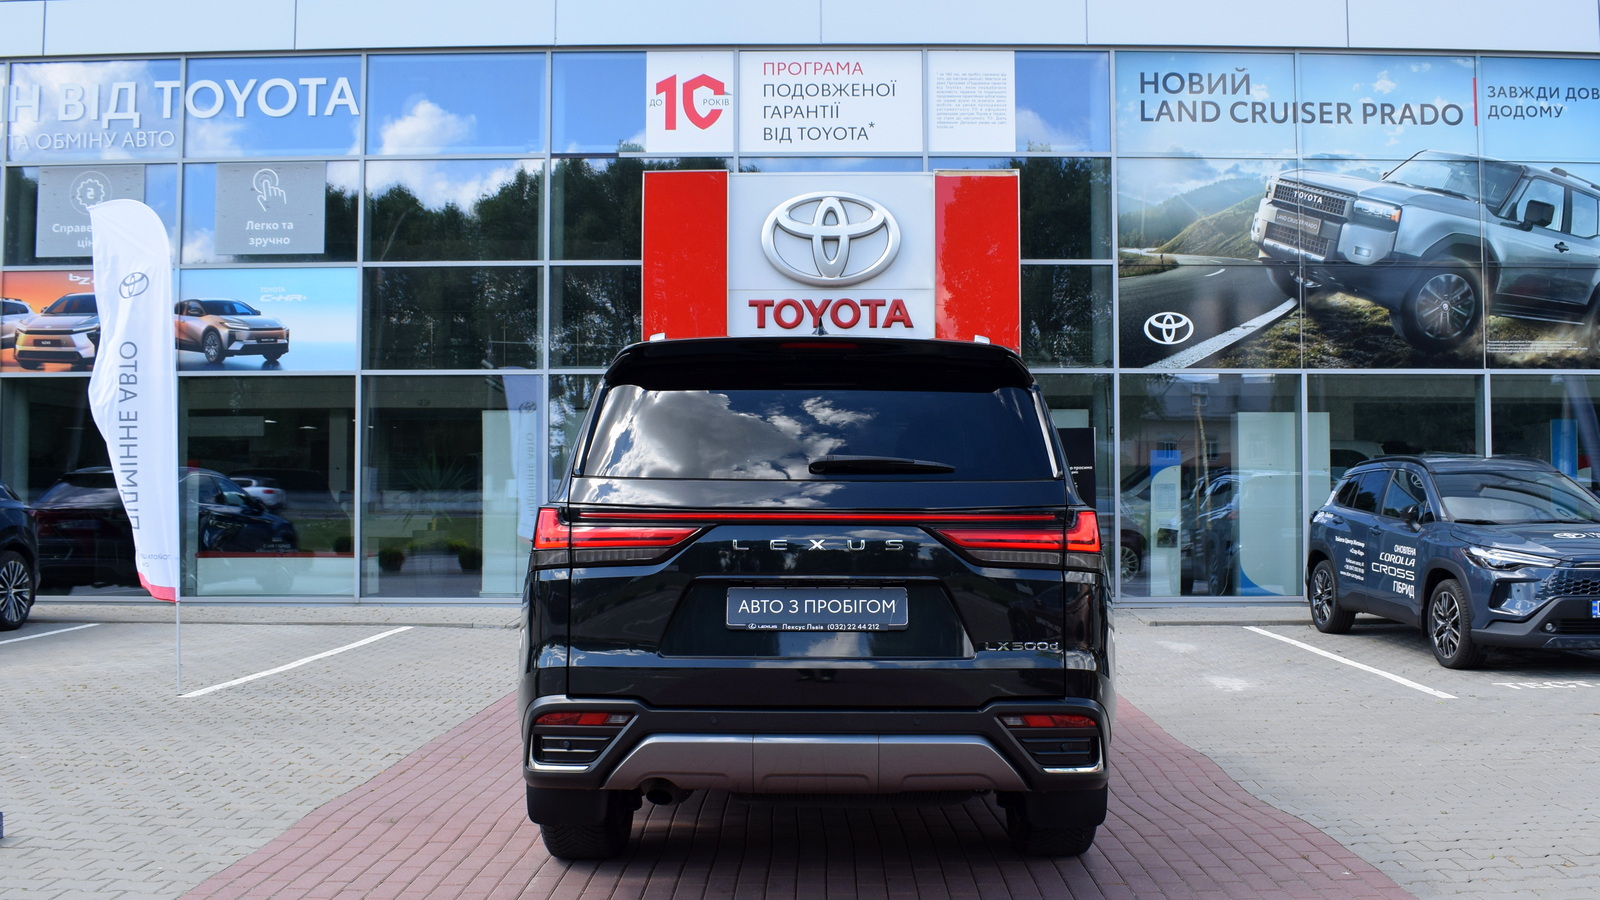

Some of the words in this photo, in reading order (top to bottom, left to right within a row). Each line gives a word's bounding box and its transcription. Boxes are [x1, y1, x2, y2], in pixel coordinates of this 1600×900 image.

[763, 62, 864, 76] ПРОГРАМА
[763, 79, 896, 99] ПОДОВЖЕНОЇ
[1140, 67, 1251, 96] НОВИЙ
[655, 73, 725, 130] 10
[1487, 85, 1561, 102] ЗАВЖДИ
[57, 82, 141, 129] ВІД
[154, 77, 361, 119] TOYOTA
[649, 99, 663, 107] ДО
[702, 98, 730, 106] РОКІВ
[763, 102, 840, 119] ГАРАНТІЇ
[1140, 99, 1225, 124] LAND
[1229, 101, 1352, 125] CRUISER
[1362, 102, 1465, 127] PRADO
[1487, 104, 1564, 121] ДОДОМУ
[7, 134, 30, 150] ТА
[35, 132, 117, 150] ОБМІНУ
[121, 130, 175, 149] АВТО
[763, 127, 793, 144] ВІД
[1294, 190, 1323, 204] TOYOTA
[52, 223, 93, 236] Справе
[246, 220, 279, 232] Легко
[282, 222, 294, 230] та
[248, 234, 290, 246] зручно
[69, 273, 94, 285] bZ
[748, 298, 914, 329] TOYOTA
[732, 539, 905, 551] LEXUS
[1379, 551, 1416, 567] COROLLA
[1371, 562, 1415, 581] CROSS
[738, 599, 784, 614] АВТО
[788, 599, 799, 614] З
[804, 599, 896, 614] ПРОБІГОМ
[781, 623, 806, 631] Лексус
[827, 623, 847, 631] (032)
[1491, 681, 1600, 690] ТЕСТ
